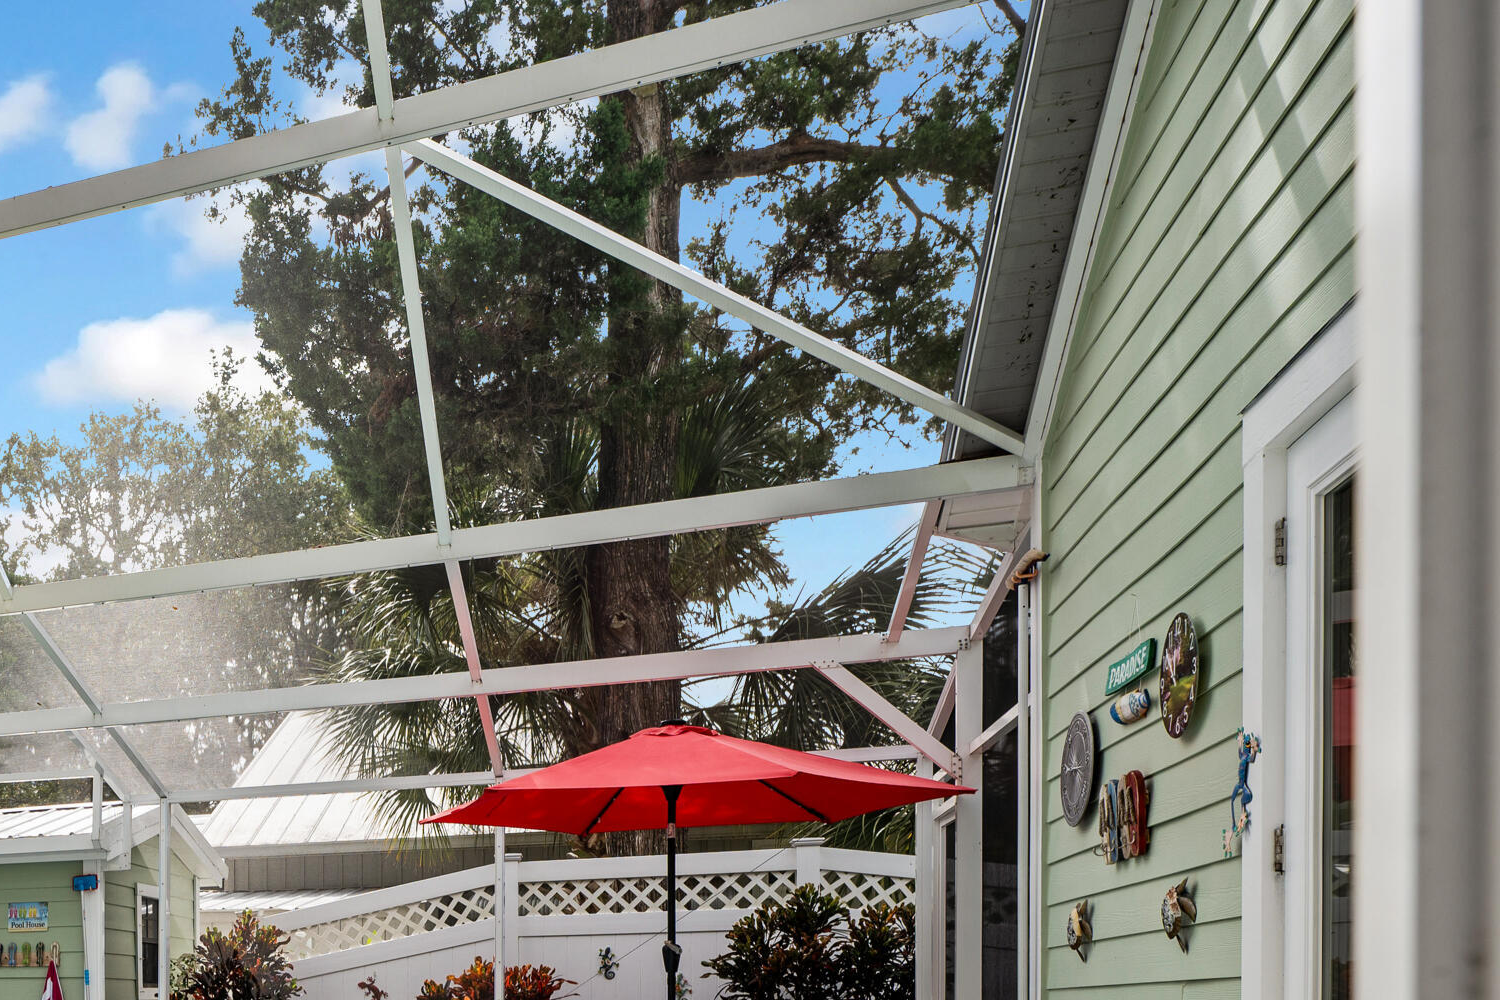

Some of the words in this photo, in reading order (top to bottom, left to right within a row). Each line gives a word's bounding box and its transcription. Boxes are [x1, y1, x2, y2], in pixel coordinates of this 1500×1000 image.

[1174, 616, 1181, 637] 12
[1168, 631, 1173, 649] 11
[1108, 646, 1147, 689] PARADISE
[11, 921, 25, 929] Pool
[26, 920, 46, 928] House
